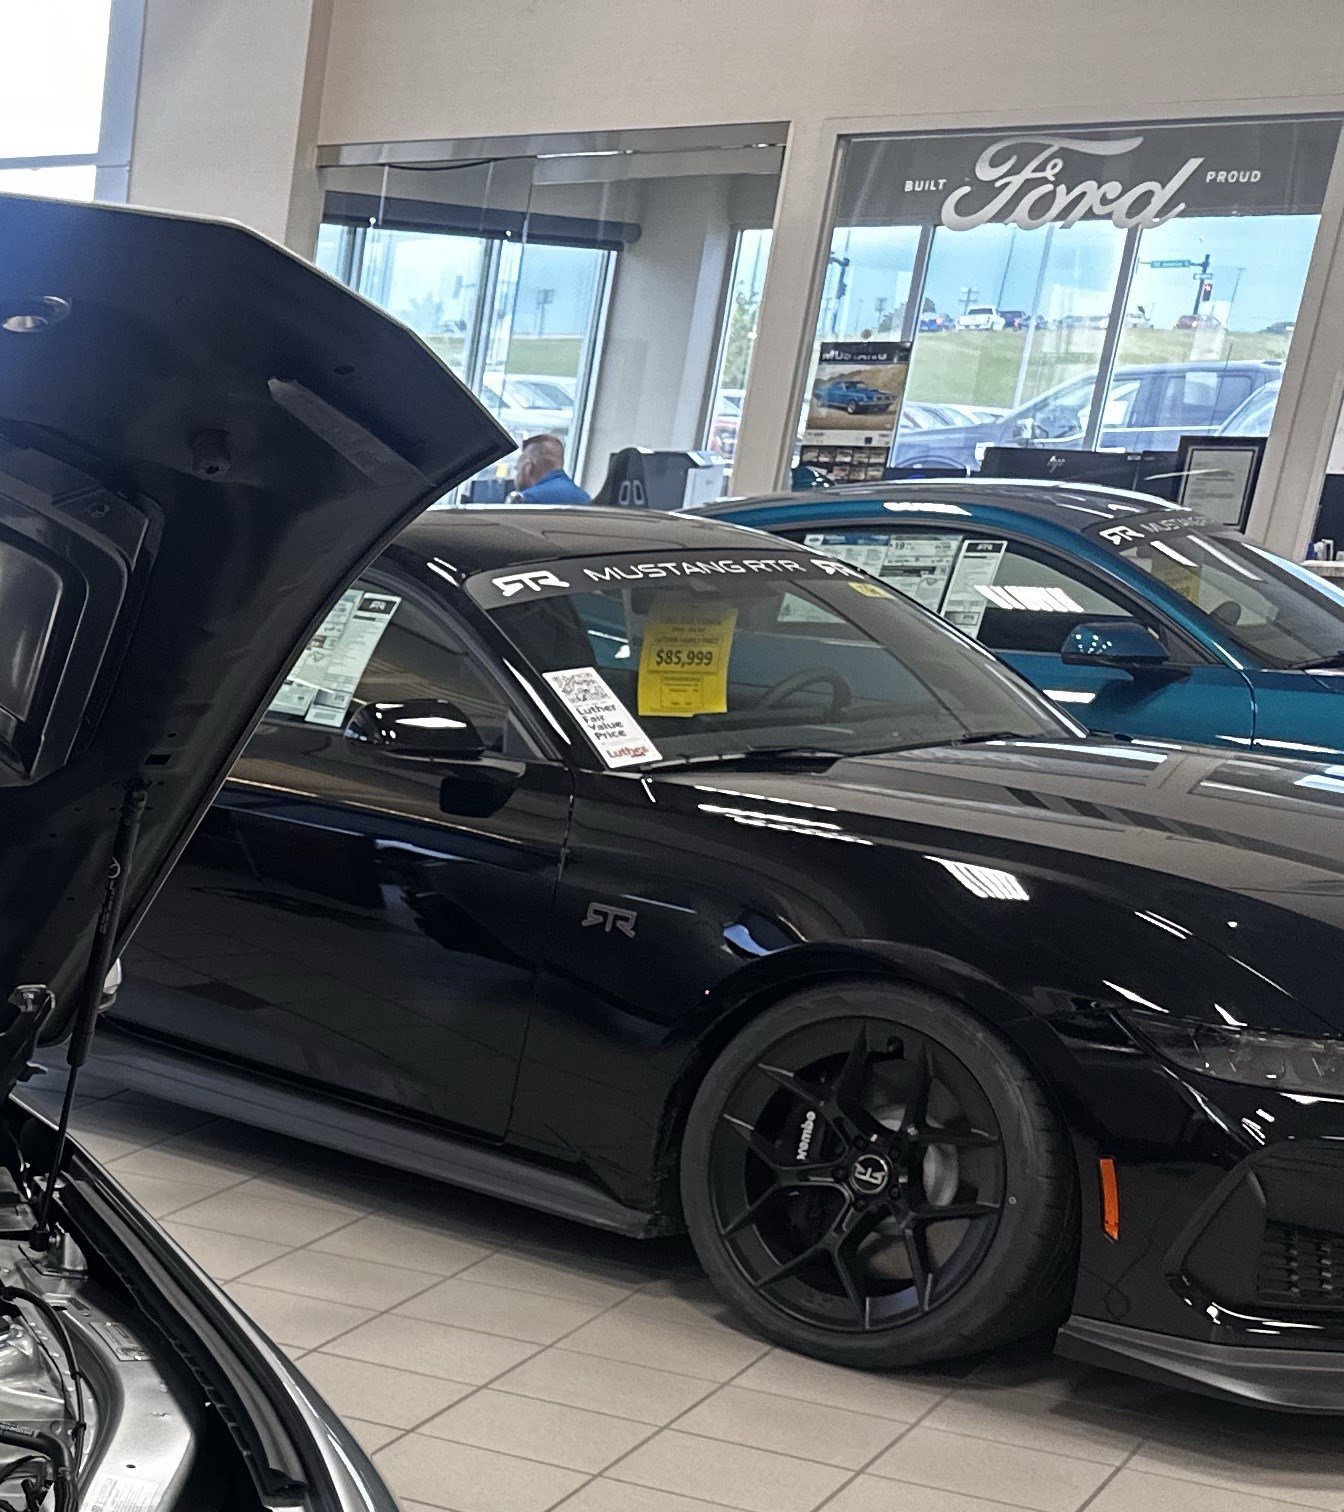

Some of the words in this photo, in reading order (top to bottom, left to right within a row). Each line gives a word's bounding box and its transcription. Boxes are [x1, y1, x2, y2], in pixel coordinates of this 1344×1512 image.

[904, 177, 947, 193] BUILT
[940, 135, 1206, 231] Ford
[1206, 169, 1262, 185] PROUD
[583, 560, 746, 582] MUSTANG
[742, 559, 806, 574] RTR
[656, 648, 713, 668] $85,999
[575, 703, 617, 716] Luther
[582, 714, 605, 723] Fair
[587, 720, 624, 731] Value
[594, 729, 627, 740] Price
